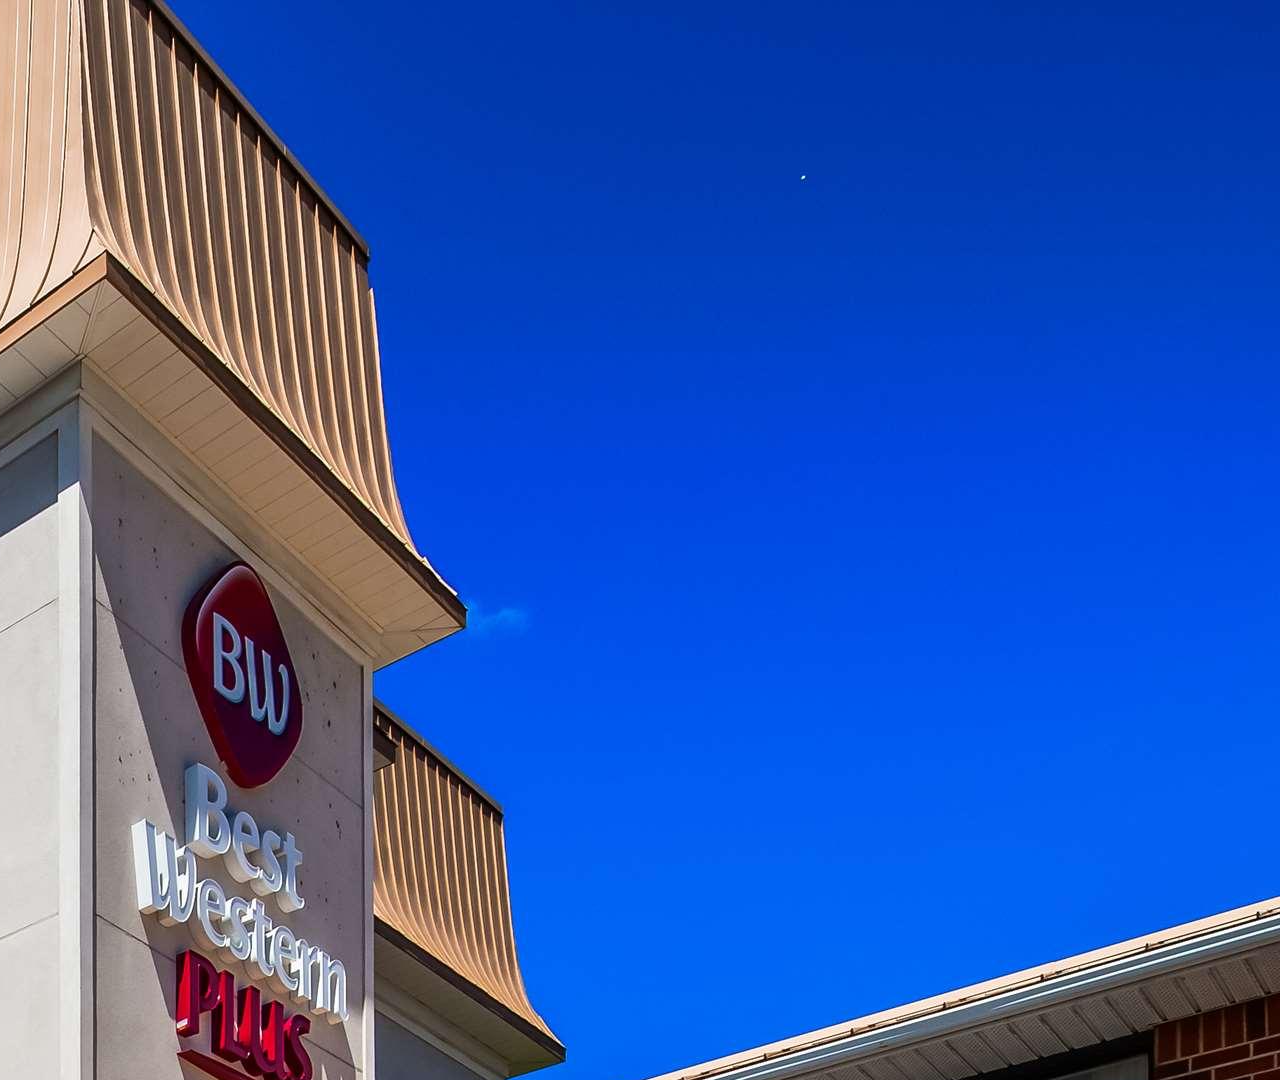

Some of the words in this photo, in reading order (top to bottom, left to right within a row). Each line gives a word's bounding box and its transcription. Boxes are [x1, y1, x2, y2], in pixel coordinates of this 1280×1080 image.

[212, 612, 290, 735] BW
[185, 762, 305, 910] Best
[131, 818, 349, 1023] Western
